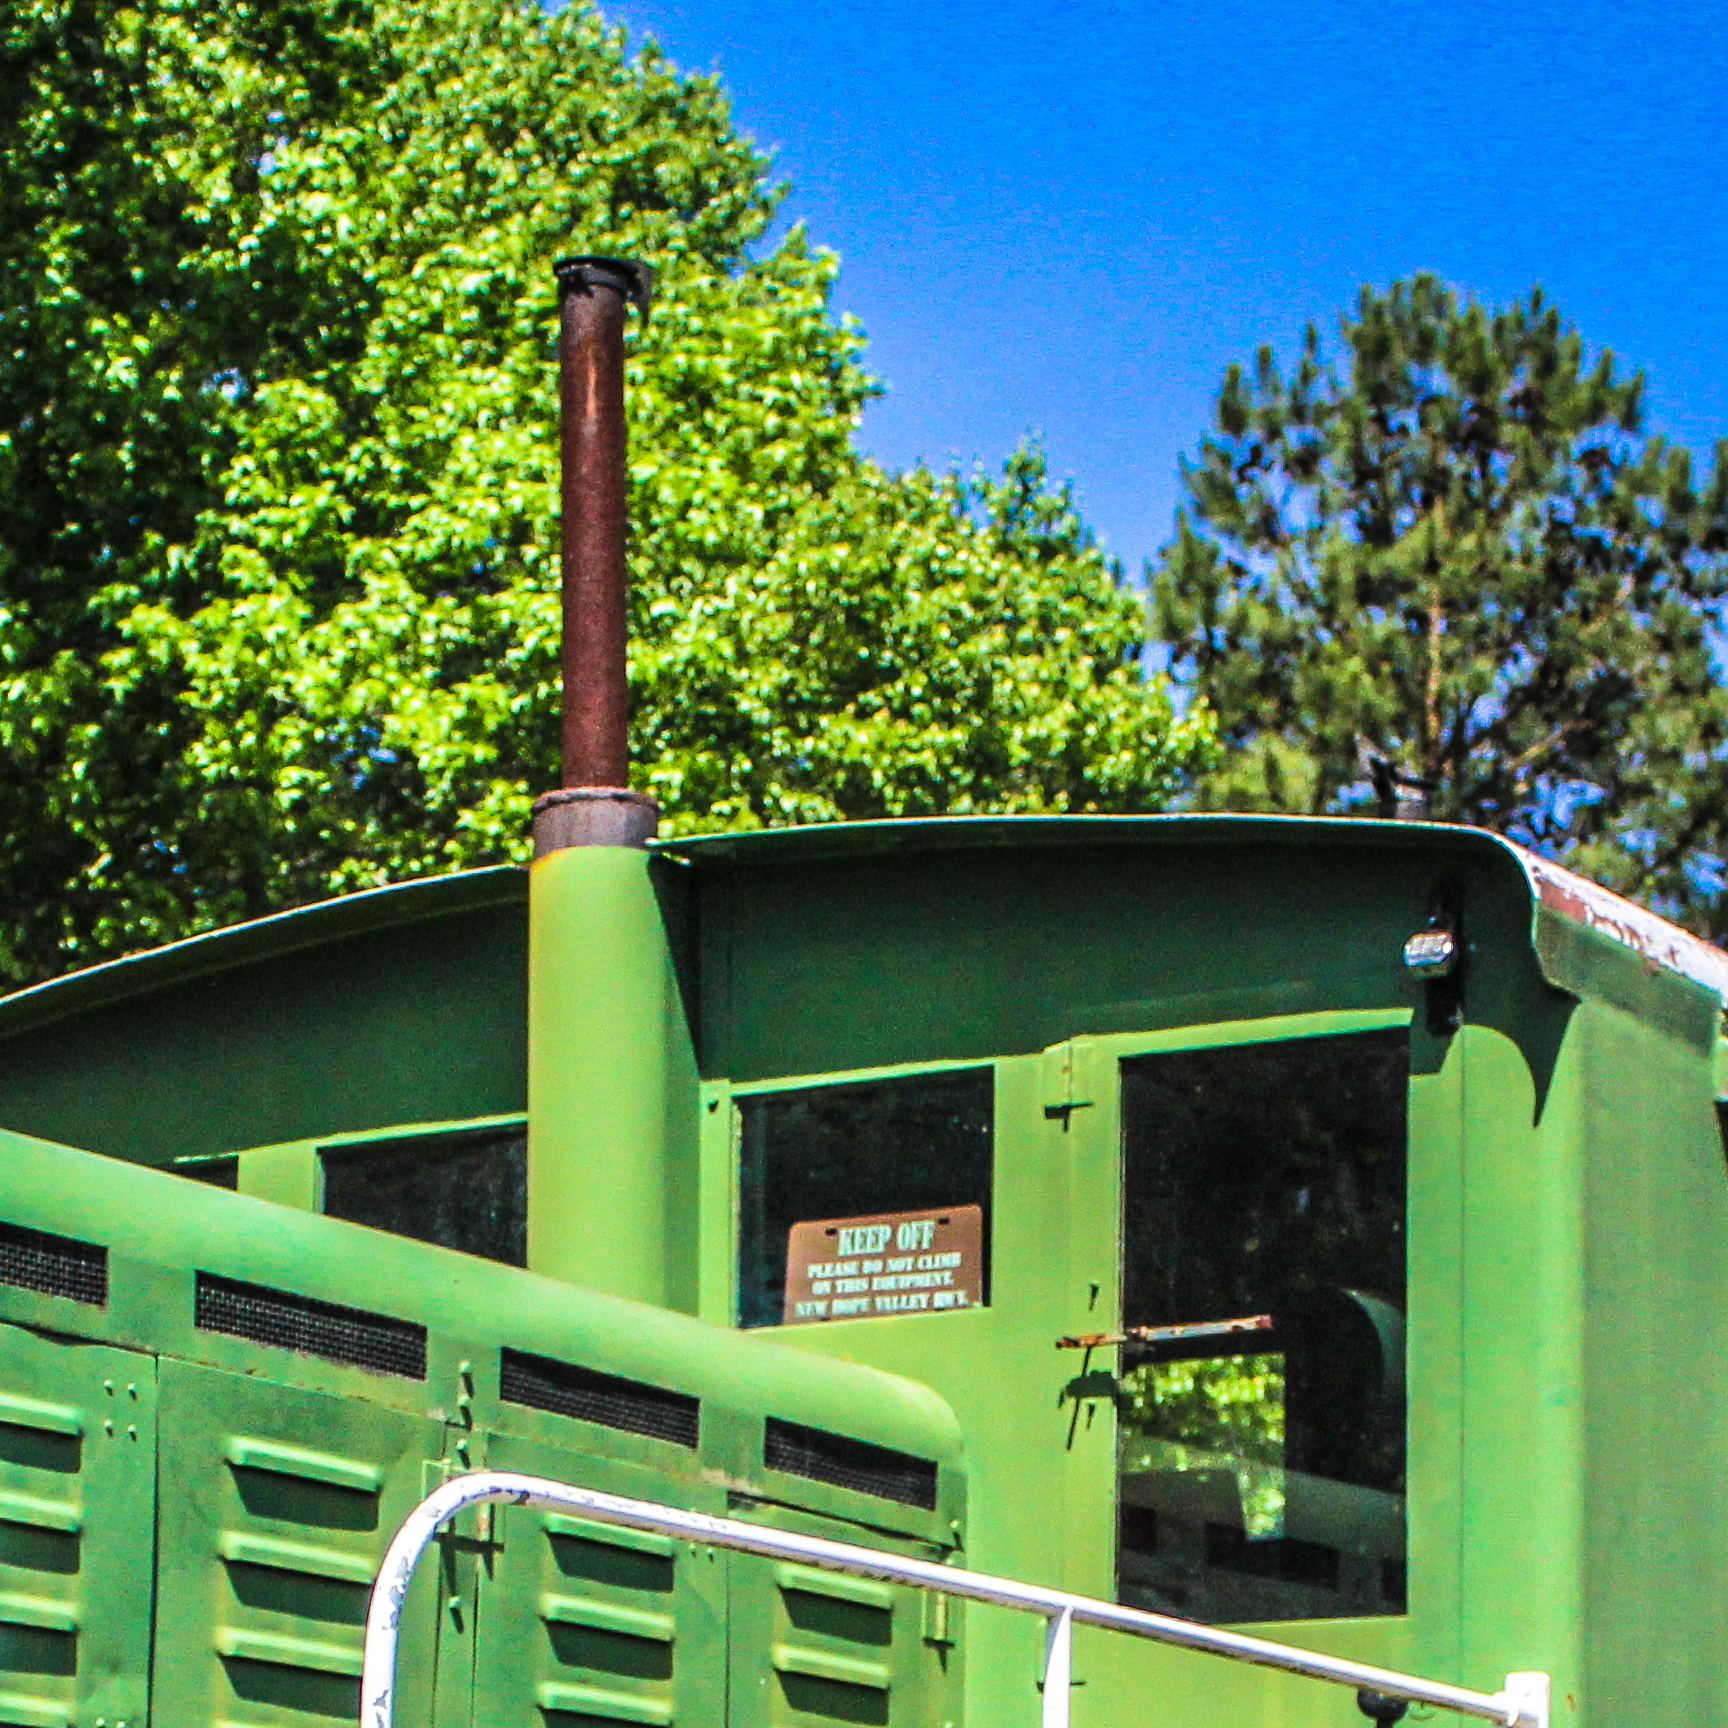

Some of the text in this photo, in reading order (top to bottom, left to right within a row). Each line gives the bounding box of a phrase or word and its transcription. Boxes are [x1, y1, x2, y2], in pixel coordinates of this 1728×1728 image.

[838, 1220, 936, 1256] KEEP OFF
[807, 1251, 962, 1279] PLEASE DO NOT CLIMB
[811, 1280, 832, 1296] ON
[835, 1277, 869, 1294] THIS
[794, 1300, 829, 1318] NEW
[831, 1297, 871, 1316] HOPE
[874, 1291, 930, 1312] VALLEY
